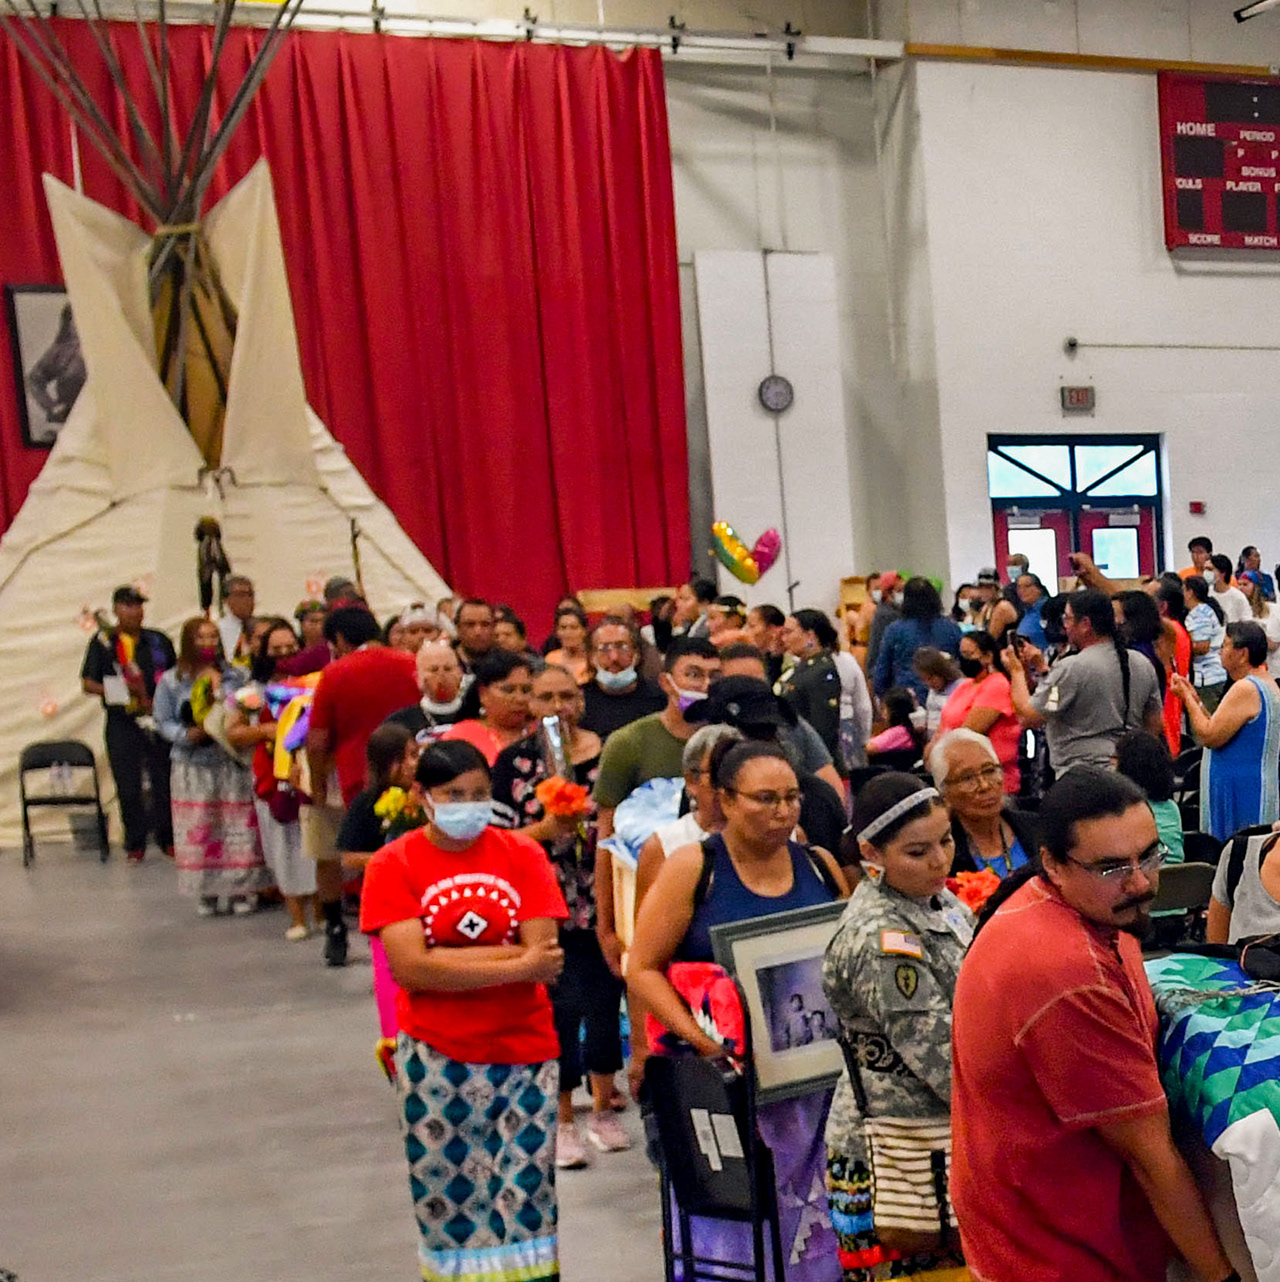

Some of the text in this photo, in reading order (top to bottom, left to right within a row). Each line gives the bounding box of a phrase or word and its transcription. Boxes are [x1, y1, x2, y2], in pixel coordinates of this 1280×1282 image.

[1176, 122, 1217, 137] HOME
[1239, 130, 1275, 142] PERIOD
[1241, 166, 1276, 178] BONUS
[1225, 181, 1262, 192] PLAYER
[1188, 234, 1221, 245] SCORE
[1244, 236, 1278, 246] MATCH
